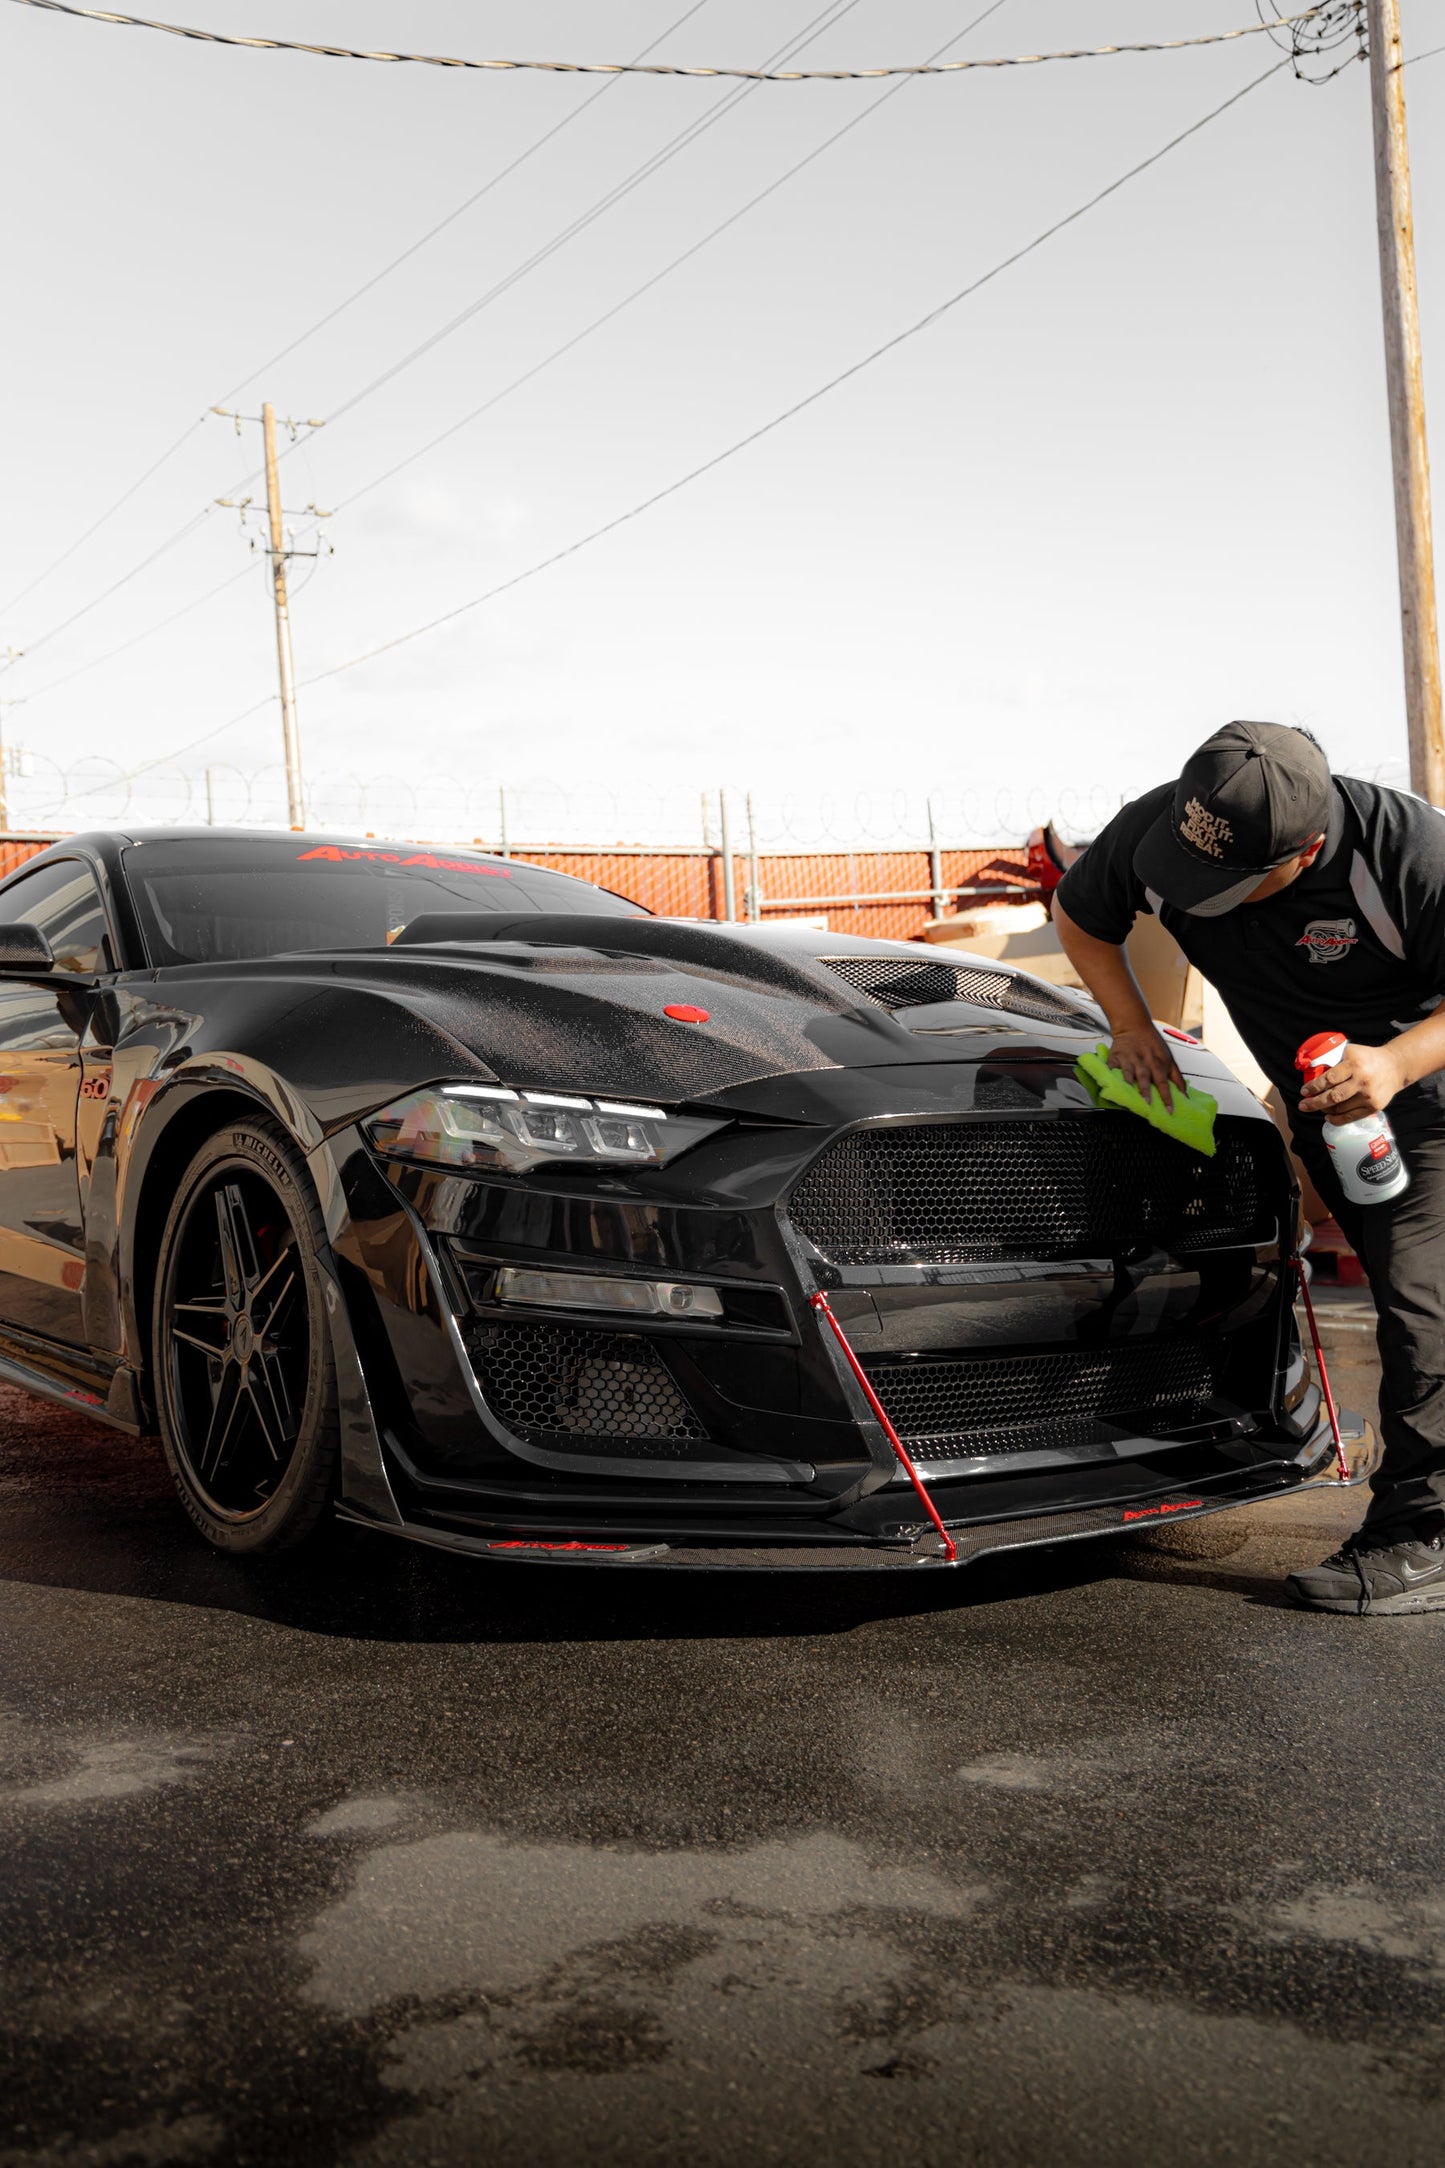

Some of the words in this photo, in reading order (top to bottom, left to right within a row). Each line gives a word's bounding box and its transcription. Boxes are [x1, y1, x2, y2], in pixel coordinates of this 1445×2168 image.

[1184, 801, 1218, 837] BREAK
[1218, 829, 1234, 843] IT.
[1191, 797, 1214, 823] MOD
[1214, 817, 1230, 832] IT.
[244, 1135, 290, 1185] MICHELIN
[1360, 1159, 1387, 1176] SPEED
